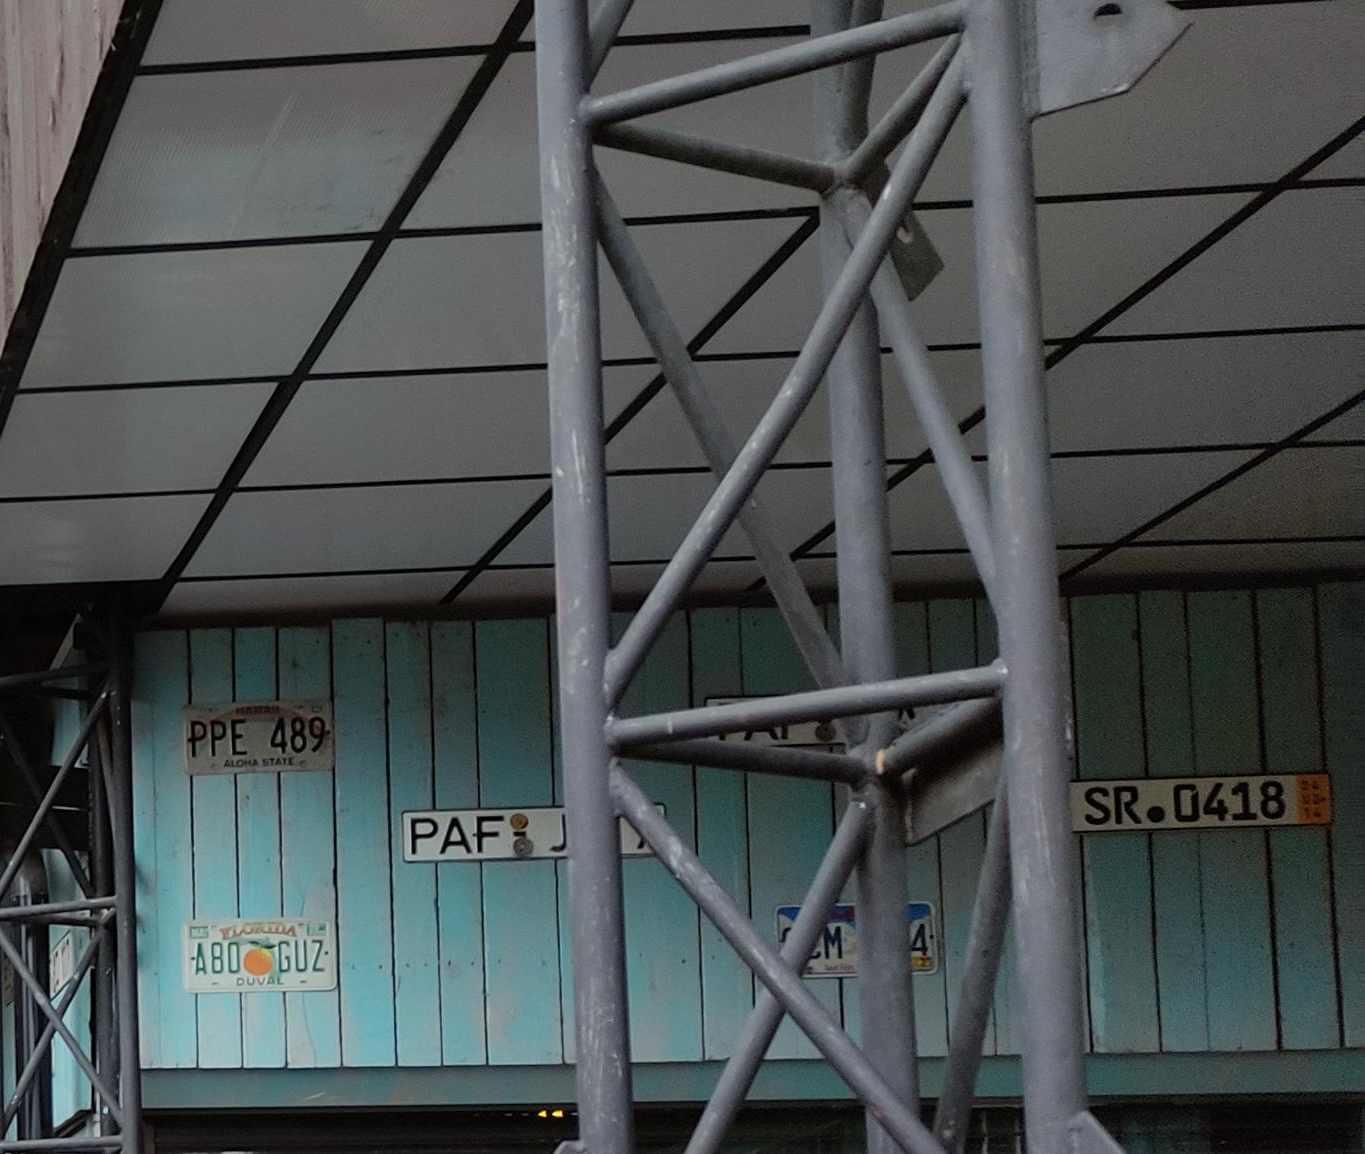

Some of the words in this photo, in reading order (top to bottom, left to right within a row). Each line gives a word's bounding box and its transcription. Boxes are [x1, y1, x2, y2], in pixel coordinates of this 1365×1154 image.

[189, 719, 248, 758] PPE
[270, 716, 327, 754] 489
[223, 759, 259, 768] ALOHA
[262, 756, 295, 767] STATE
[409, 815, 505, 855] PAF
[220, 924, 298, 941] FLORIDA
[276, 938, 325, 974] GUZ
[236, 977, 283, 987] DUVAL
